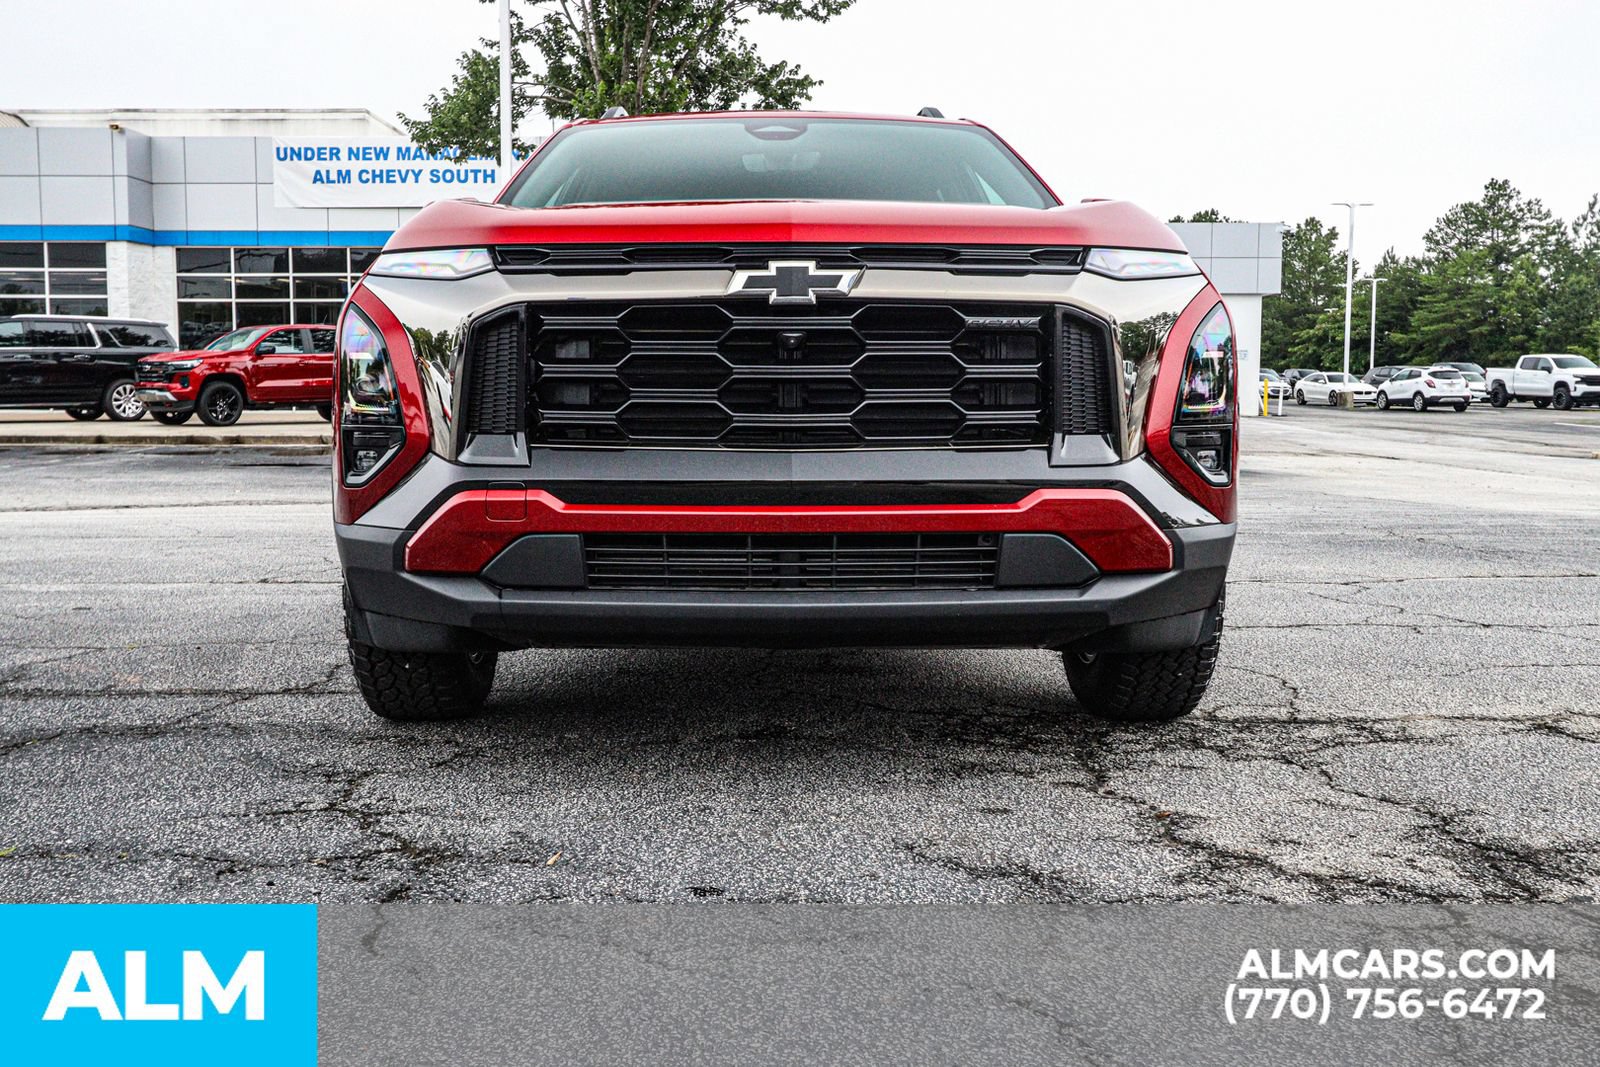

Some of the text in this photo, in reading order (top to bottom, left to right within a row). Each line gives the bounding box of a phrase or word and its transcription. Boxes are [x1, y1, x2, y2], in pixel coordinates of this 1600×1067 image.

[275, 146, 341, 162] UNDER
[348, 146, 391, 161] NEW
[312, 168, 496, 185] ALM CHEVY SOUTH
